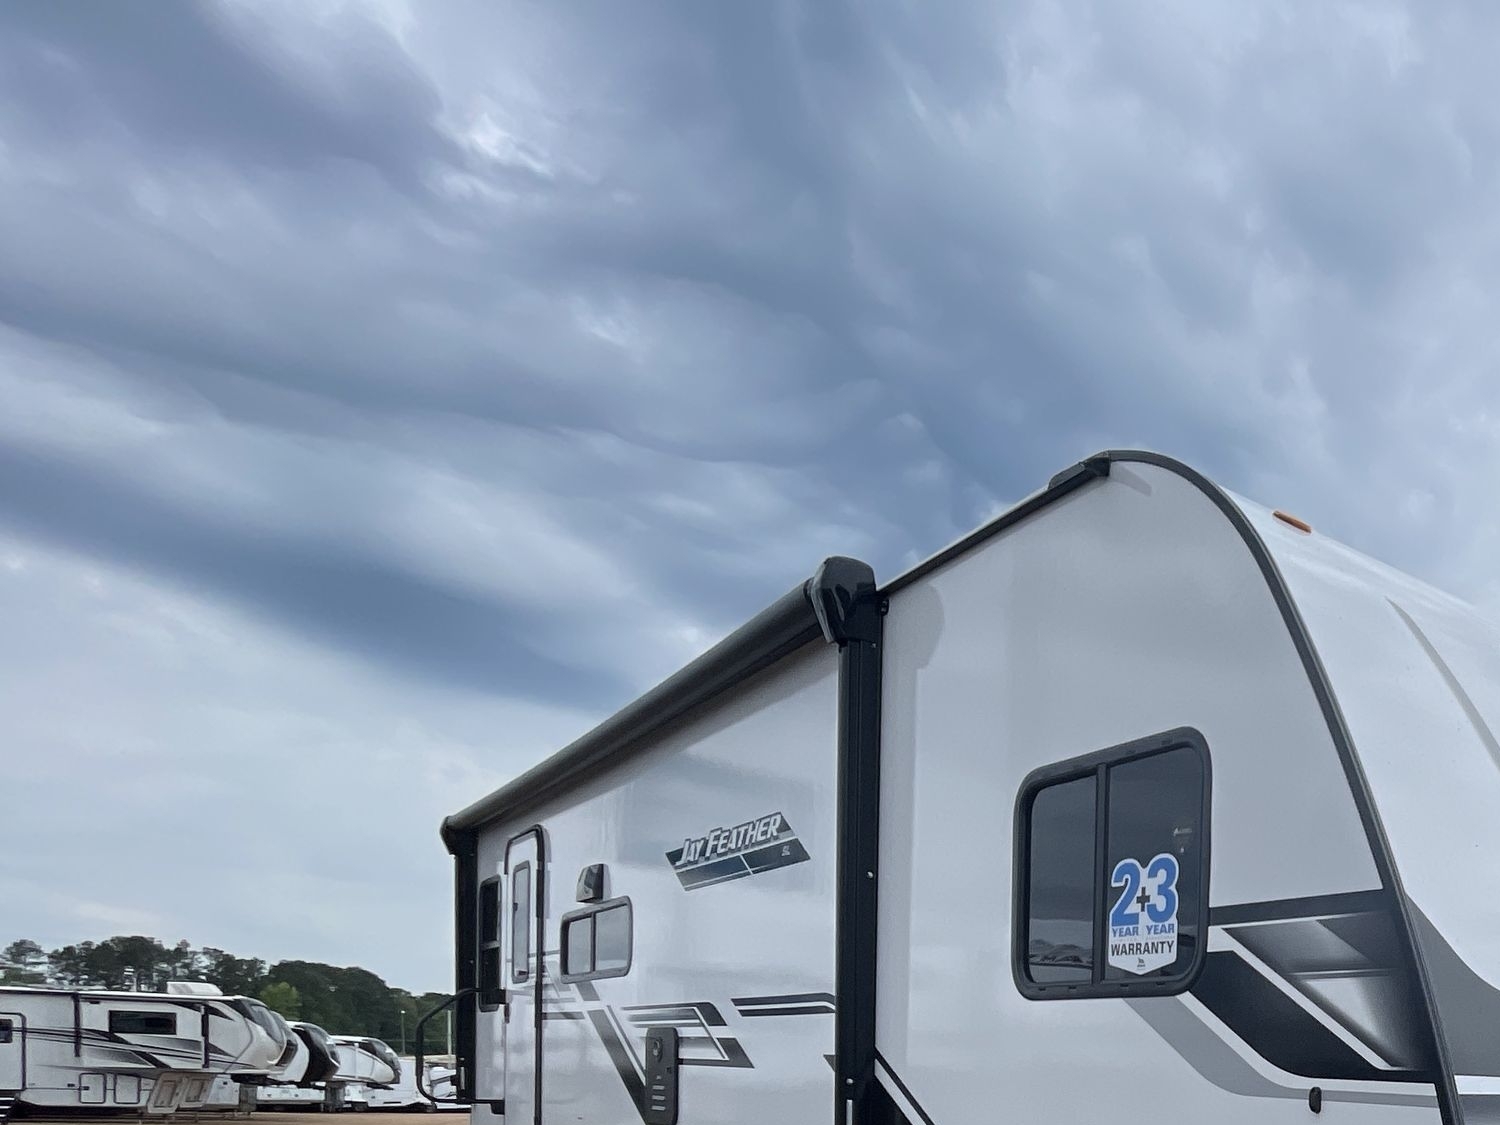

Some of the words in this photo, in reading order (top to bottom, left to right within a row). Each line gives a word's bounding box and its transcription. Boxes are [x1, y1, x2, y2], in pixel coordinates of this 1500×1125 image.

[704, 814, 781, 858] FEATHER
[1112, 926, 1139, 937] YEAR
[1146, 923, 1175, 935] YEAR
[1111, 940, 1175, 957] WARRANTY
